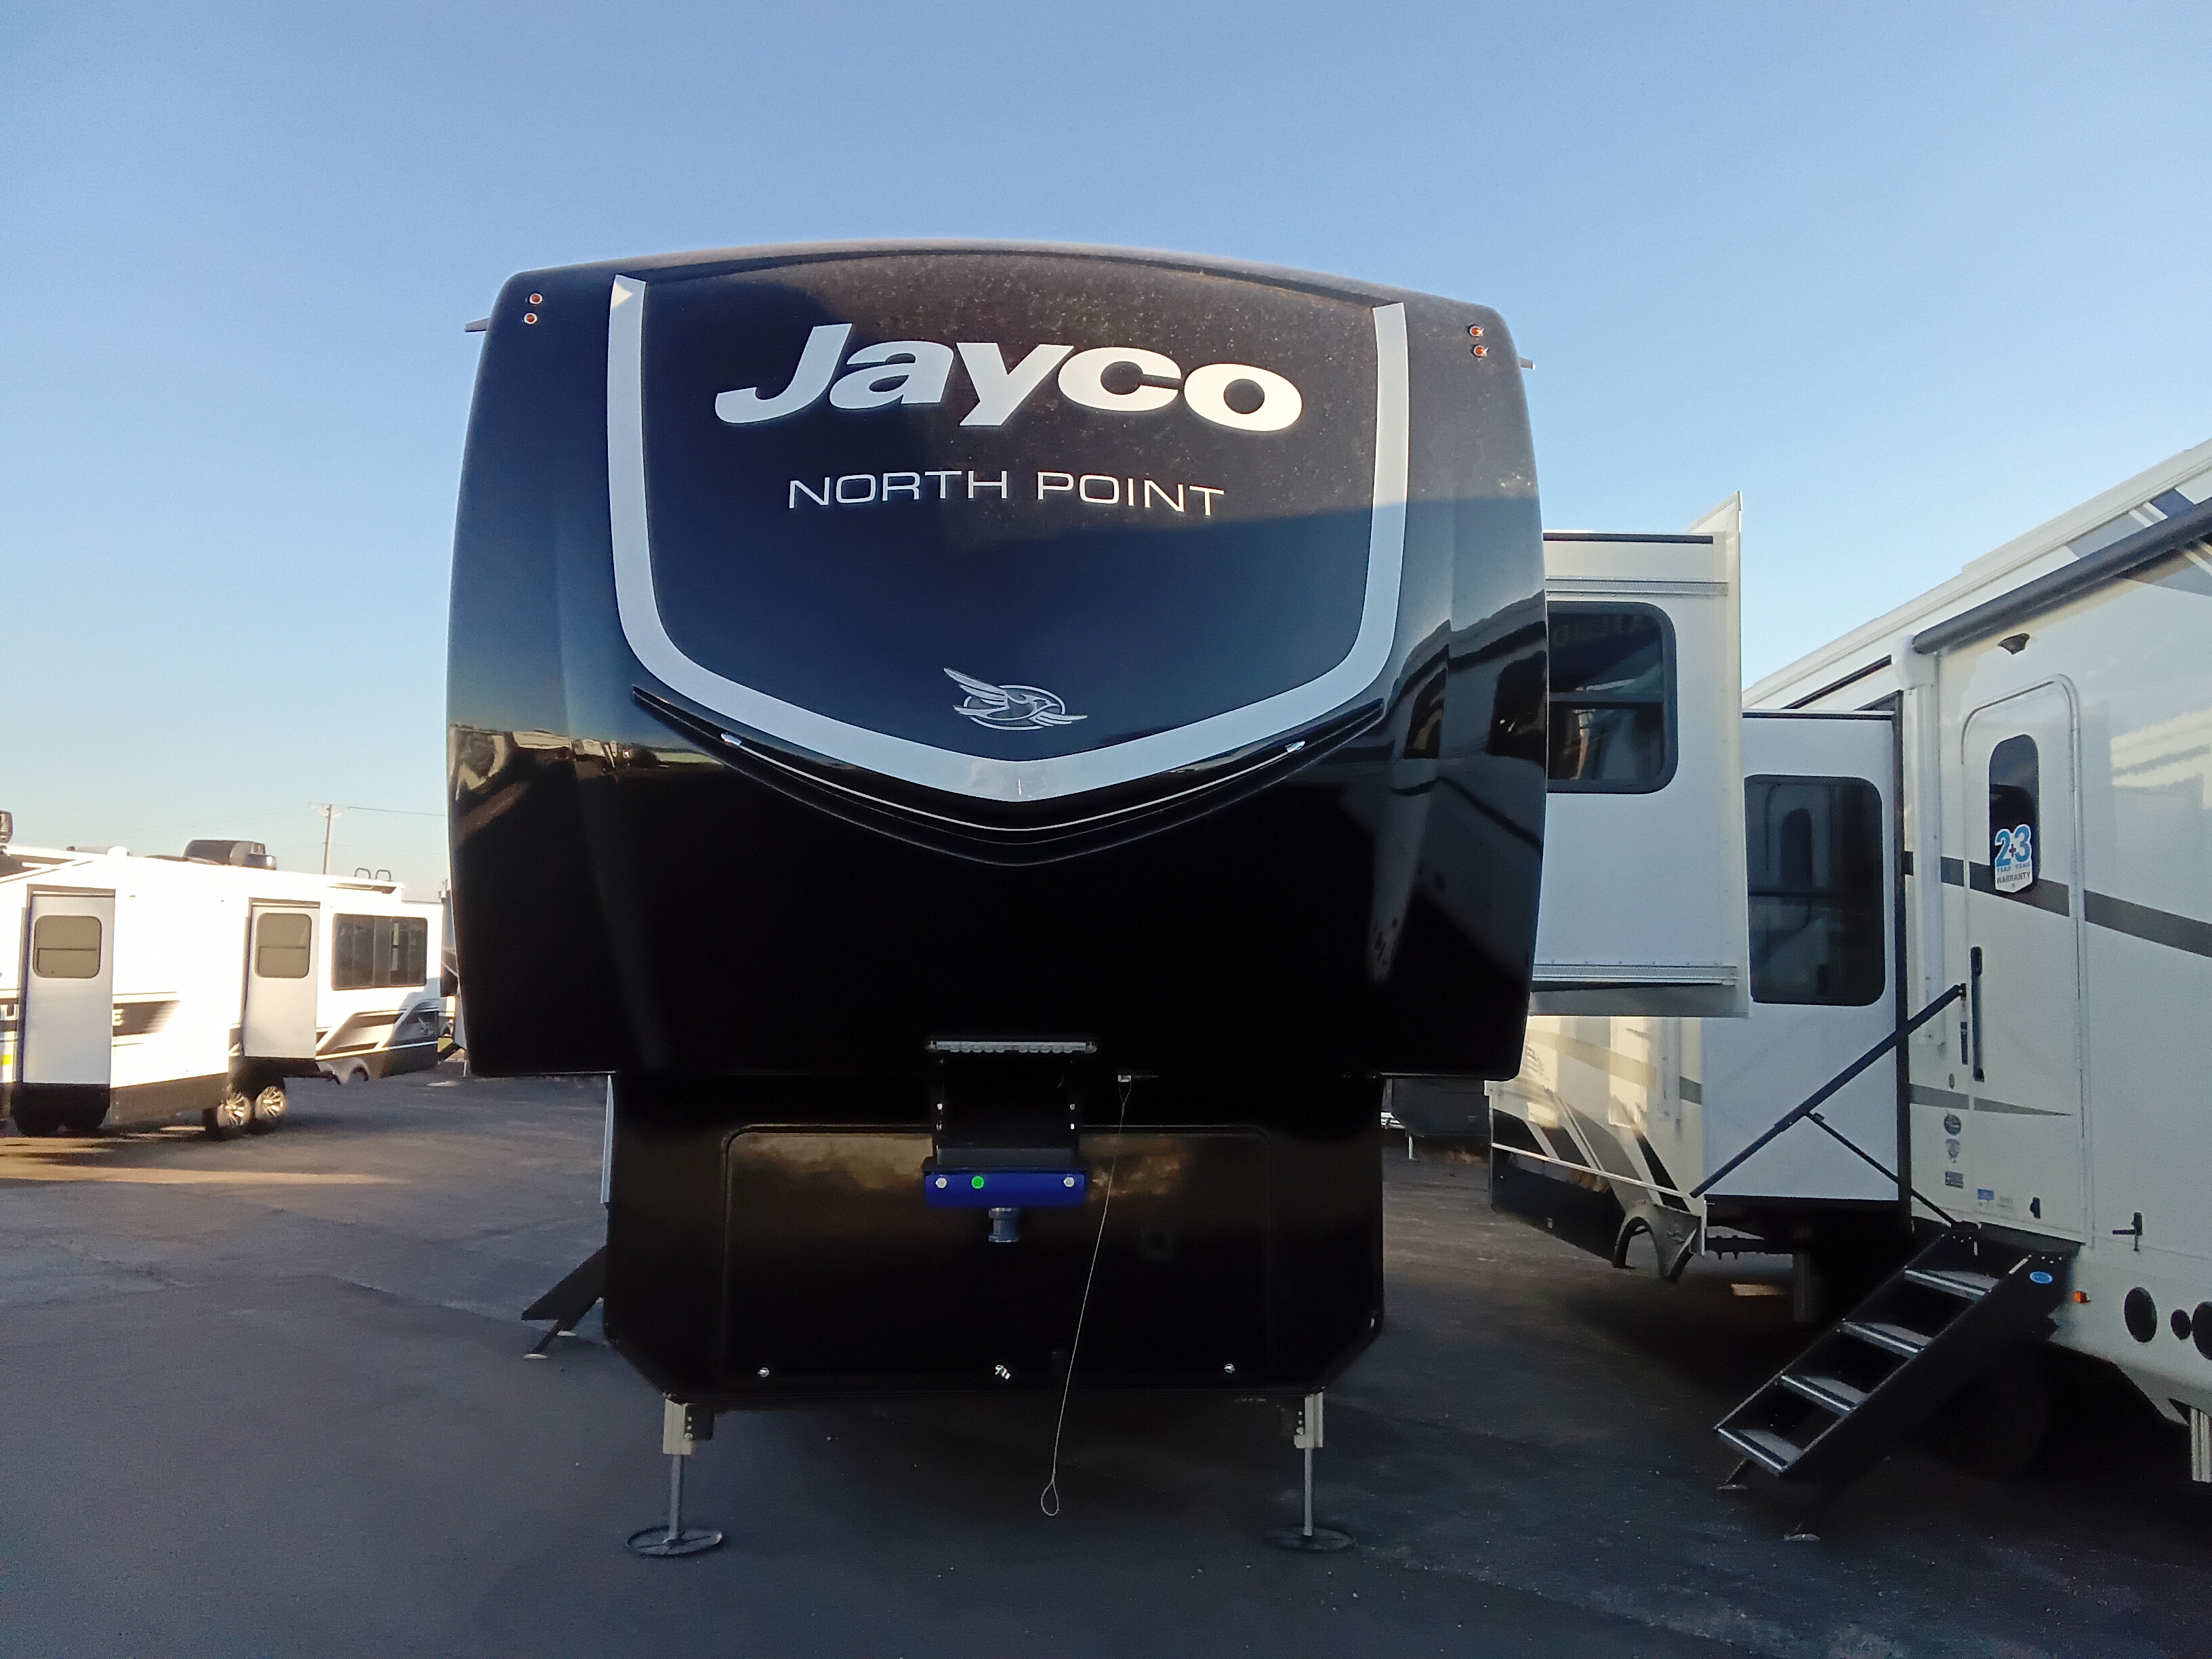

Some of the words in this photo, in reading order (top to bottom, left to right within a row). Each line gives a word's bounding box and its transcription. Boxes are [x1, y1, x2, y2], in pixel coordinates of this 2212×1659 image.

[714, 323, 1303, 432] Jayco
[789, 470, 1008, 509] NORTH
[1037, 471, 1225, 516] POINT
[1996, 872, 2031, 884] WARRANTY
